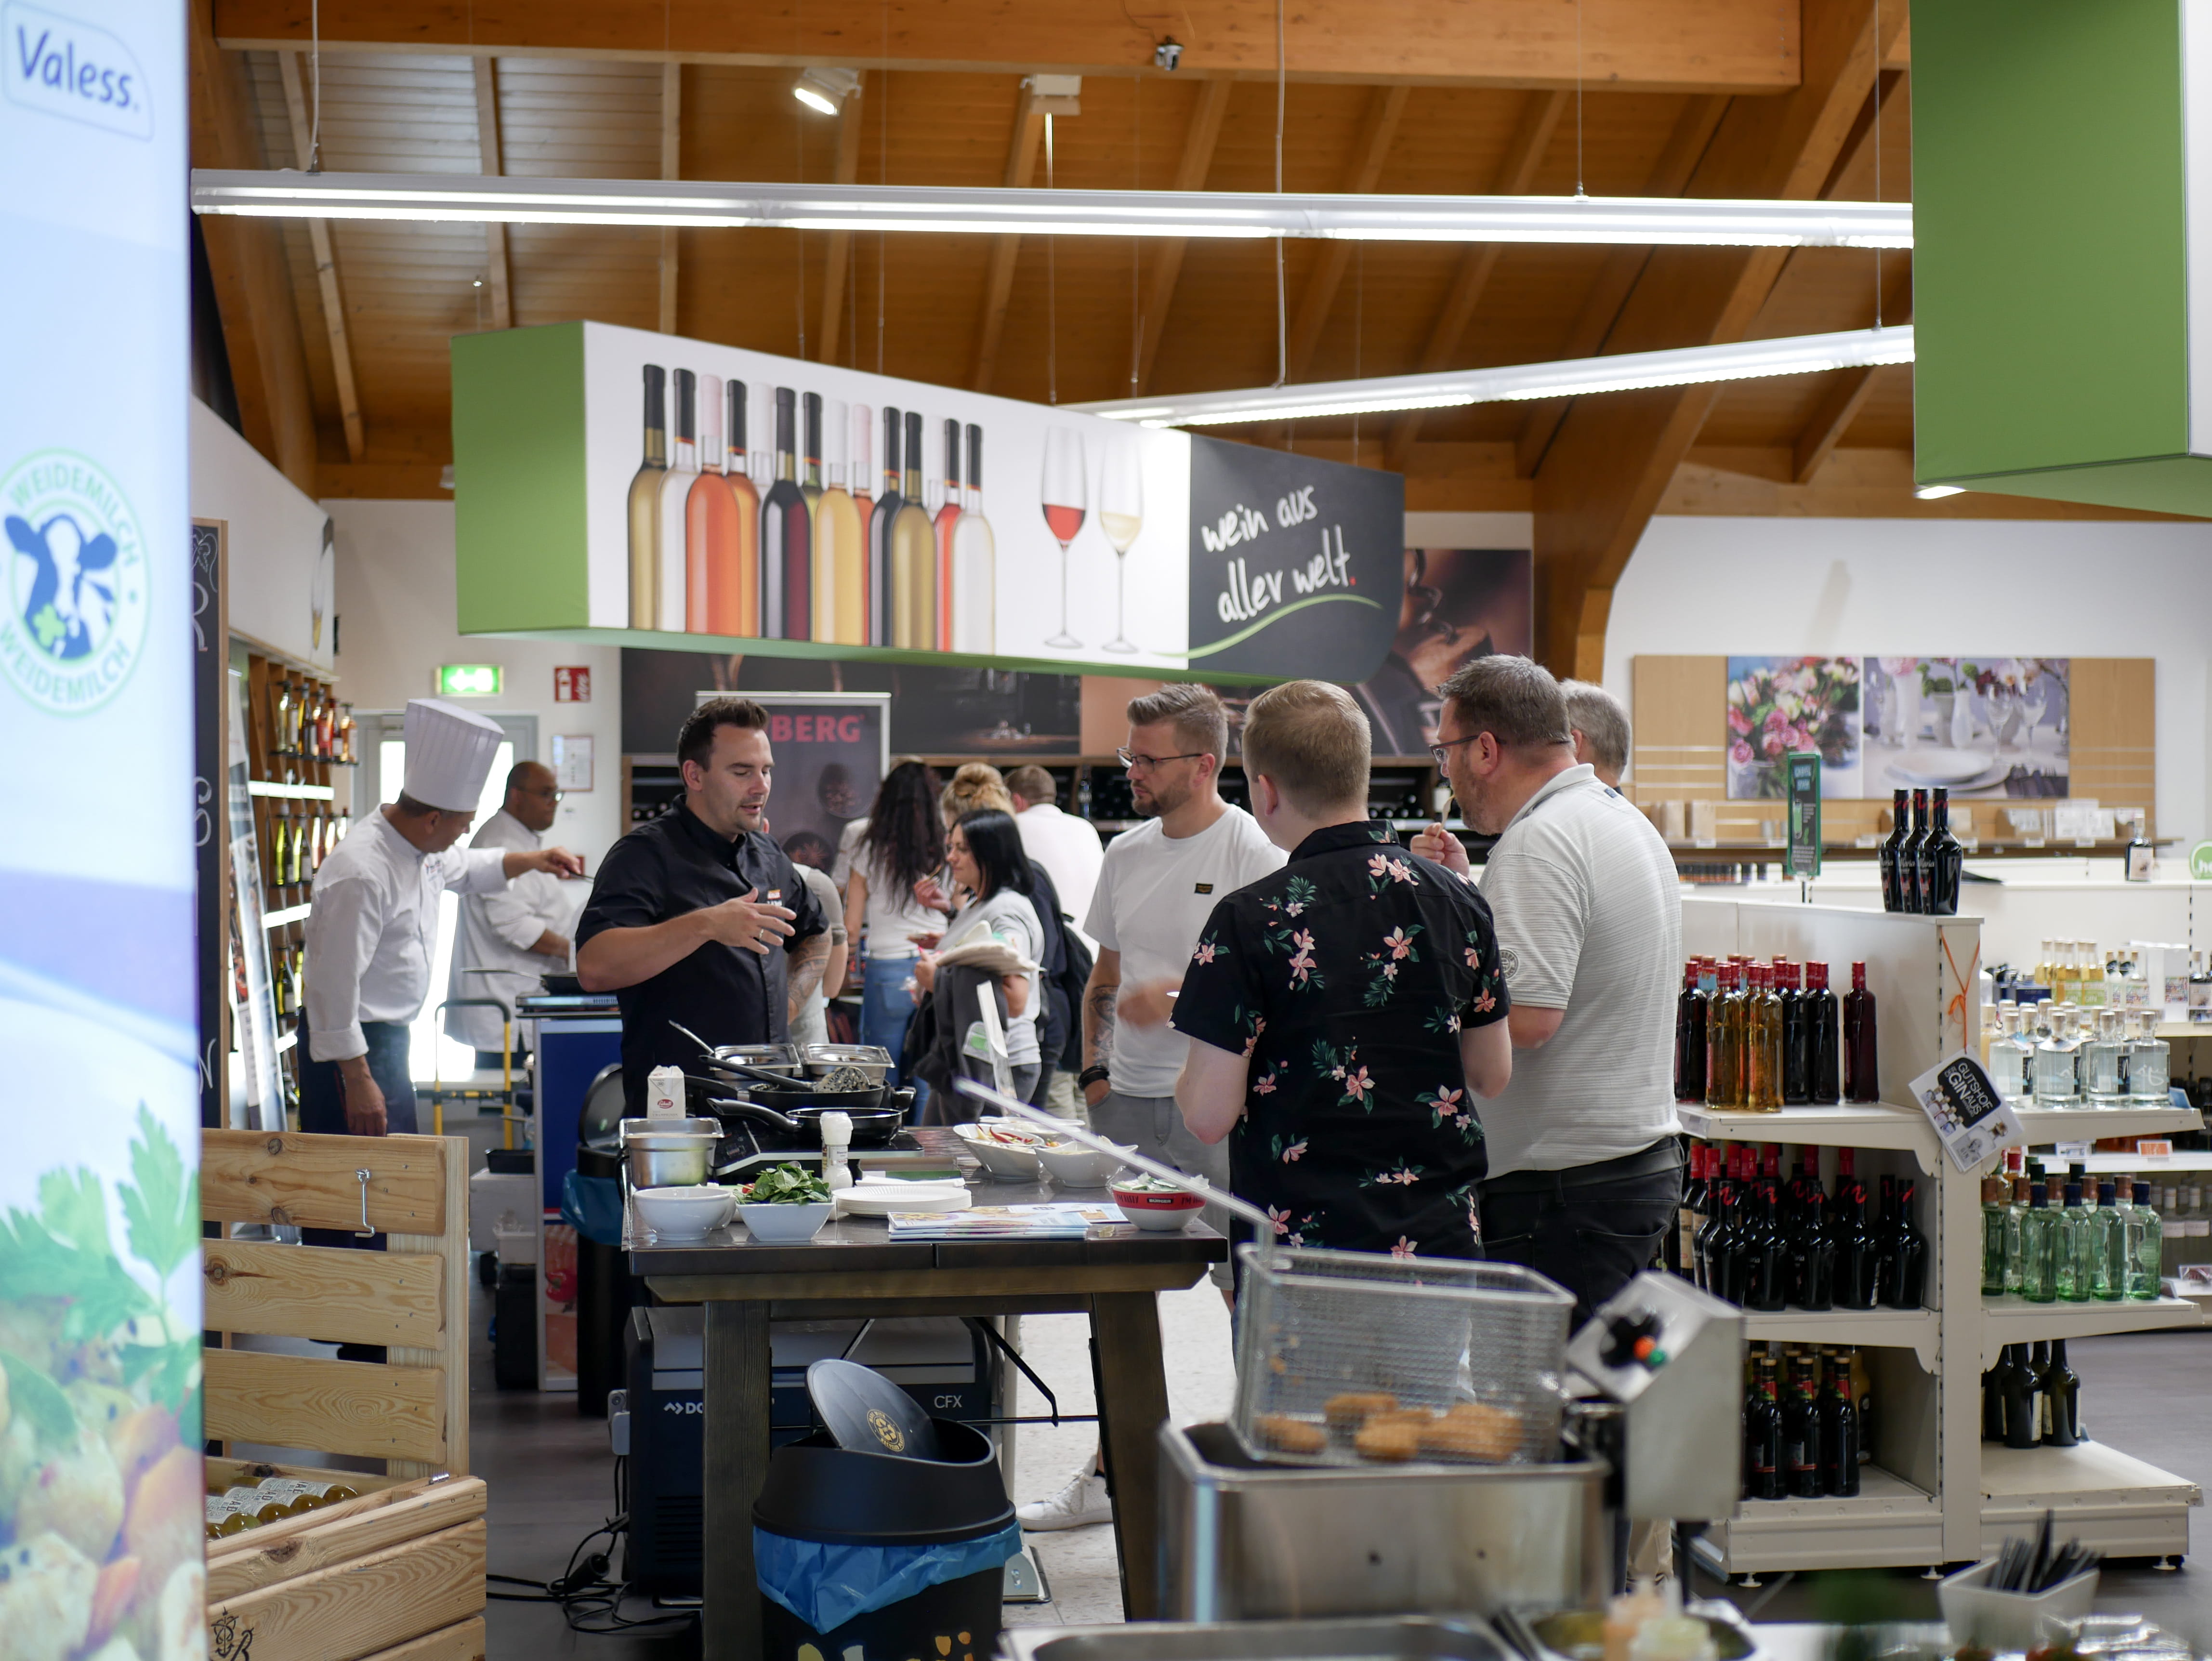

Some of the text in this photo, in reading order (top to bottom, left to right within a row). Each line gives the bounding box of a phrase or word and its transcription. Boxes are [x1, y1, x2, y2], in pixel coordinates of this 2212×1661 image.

[10, 462, 140, 567] WEIDEMILCH
[1201, 485, 1318, 552] wein aus
[1218, 524, 1356, 622] aller welt.
[1, 620, 131, 704] WEIDEMILCH
[771, 714, 861, 743] BERG
[1949, 1072, 1972, 1100] GIN
[1965, 1095, 1982, 1115] AUS
[1958, 1062, 1993, 1109] GUTSHOF
[934, 1395, 962, 1409] CFX
